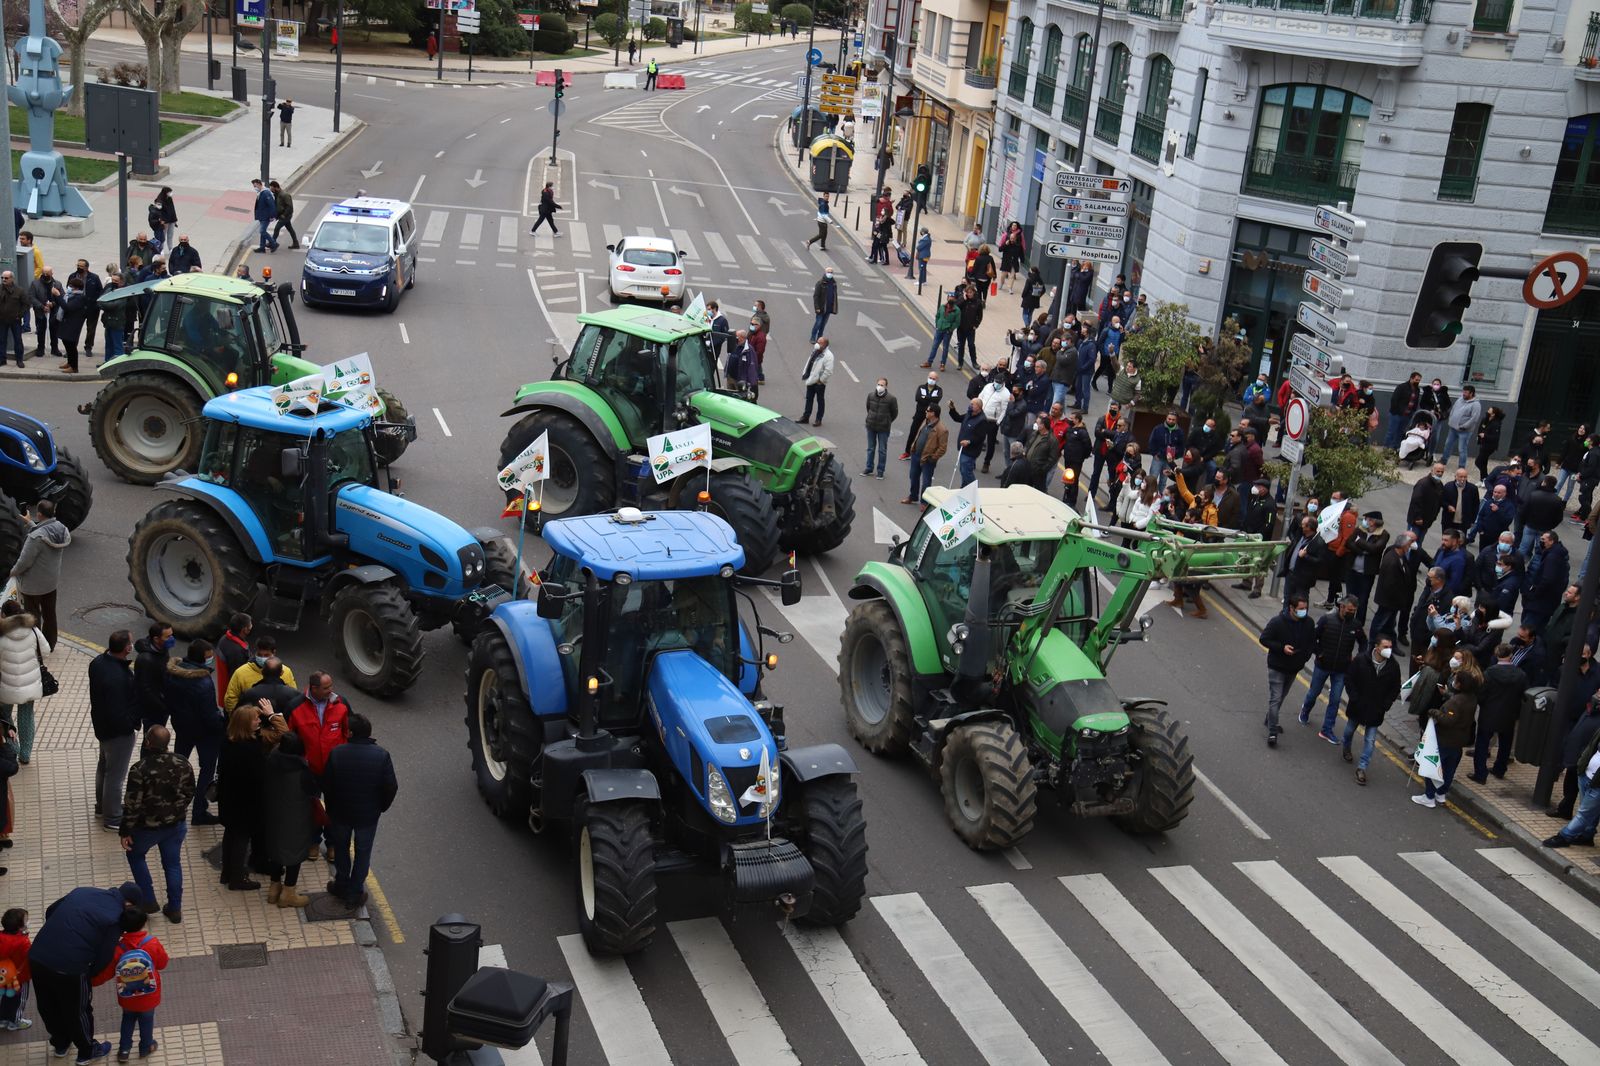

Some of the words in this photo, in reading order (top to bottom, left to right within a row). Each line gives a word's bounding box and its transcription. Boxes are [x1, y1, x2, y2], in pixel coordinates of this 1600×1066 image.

[1058, 180, 1096, 188] FERMOSELLE
[1059, 174, 1103, 184] FUENTESAUCO
[1085, 203, 1126, 213] SALAMANCA
[1086, 230, 1122, 239] VALLADOLID
[1081, 250, 1118, 260] Hospitales
[656, 469, 674, 480] UPA
[504, 478, 522, 489] UPA
[339, 502, 366, 514] Legend
[944, 536, 960, 549] UPA
[1086, 546, 1115, 559] DEUTZ-FAHR
